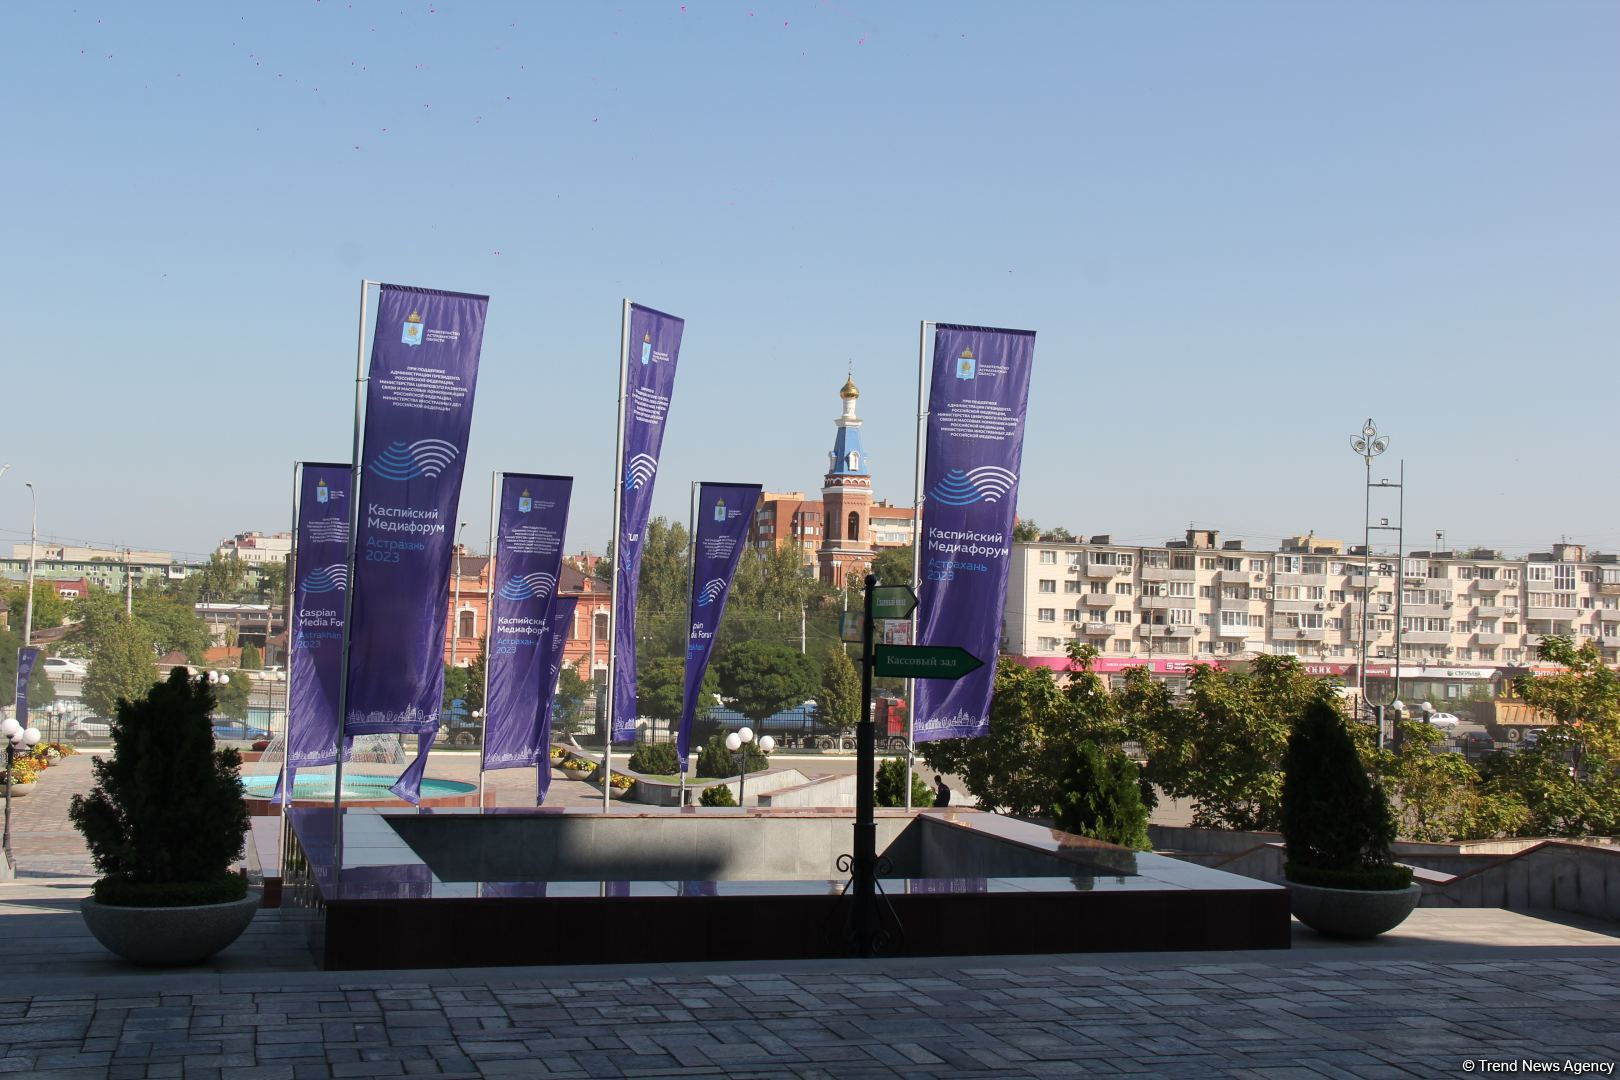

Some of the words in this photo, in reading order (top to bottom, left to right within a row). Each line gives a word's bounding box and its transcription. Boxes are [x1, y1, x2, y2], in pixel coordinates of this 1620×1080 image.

[369, 504, 439, 519] Каспийский
[368, 517, 444, 535] Медиафорум
[929, 527, 1002, 542] Каспийский
[368, 536, 424, 551] Астрахань
[929, 541, 1008, 558] Медиафорум
[366, 550, 400, 562] 2023
[928, 558, 988, 572] Астрахань
[928, 570, 954, 580] 2023
[300, 608, 336, 618] Caspian
[300, 618, 328, 626] Media
[331, 618, 344, 626] For
[498, 626, 550, 635] Медиаформ
[497, 646, 516, 654] 2023
[887, 656, 936, 665] Кассовый
[940, 659, 956, 667] зал
